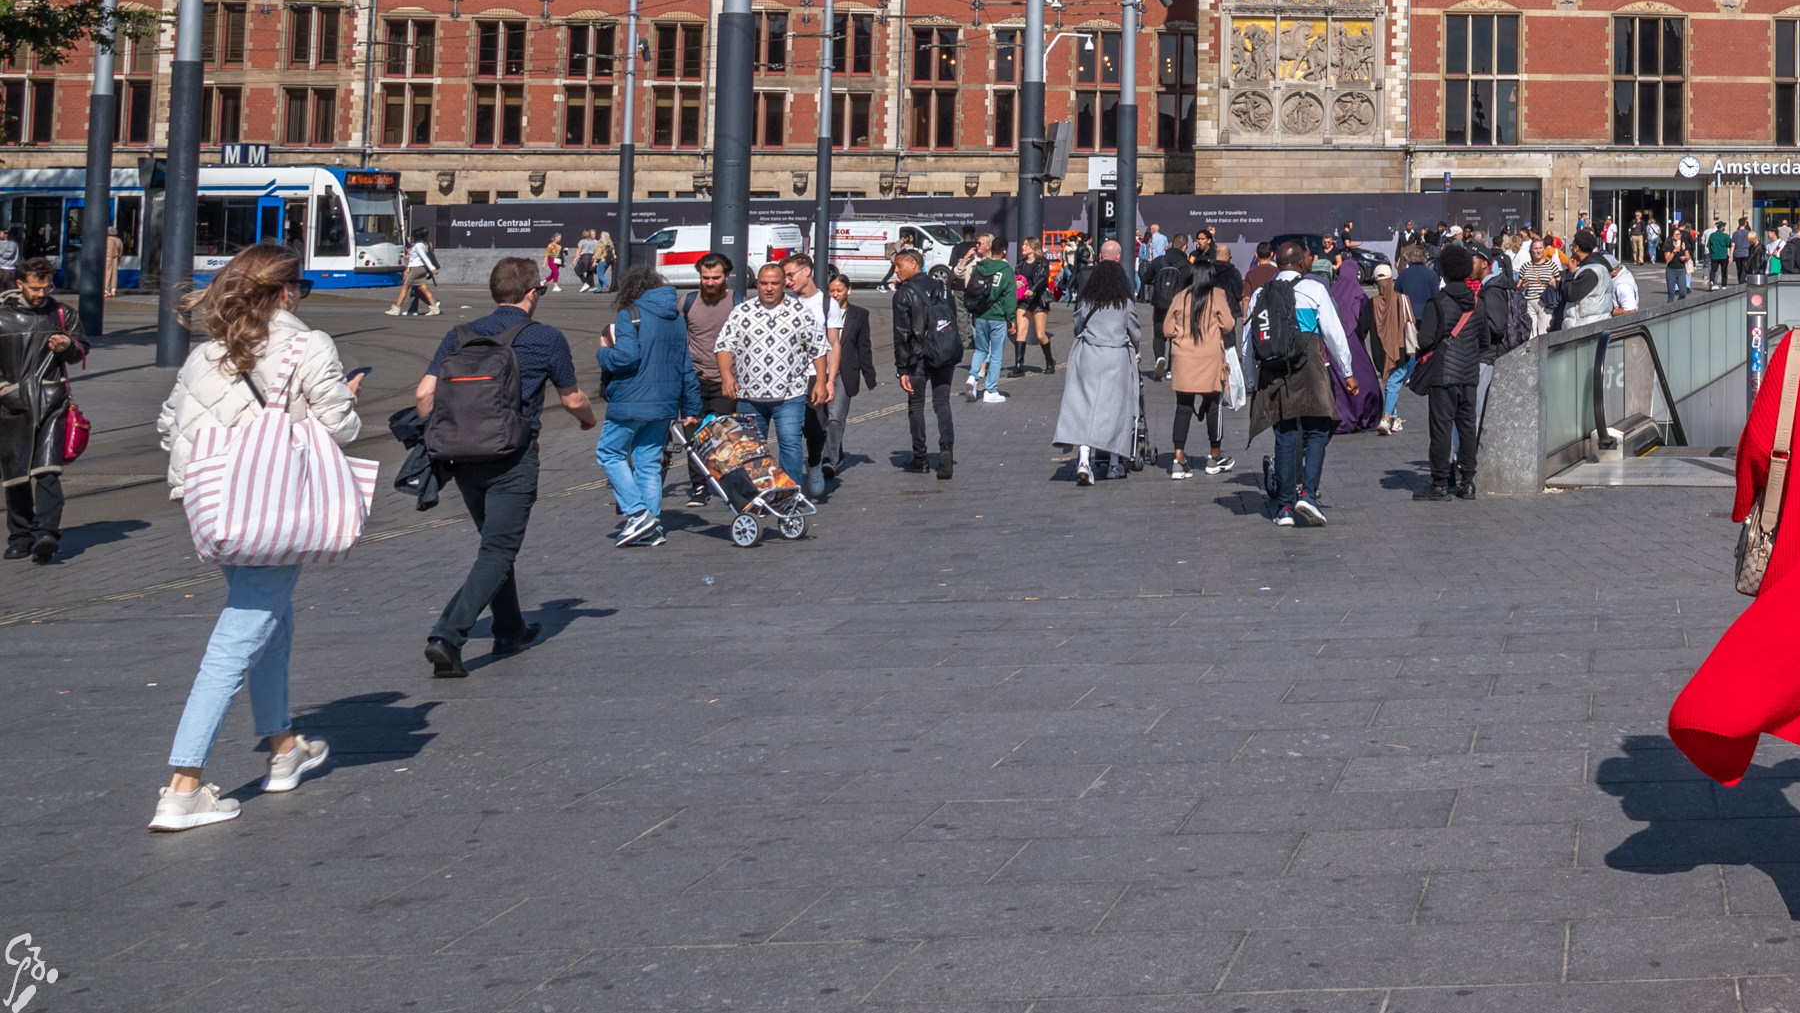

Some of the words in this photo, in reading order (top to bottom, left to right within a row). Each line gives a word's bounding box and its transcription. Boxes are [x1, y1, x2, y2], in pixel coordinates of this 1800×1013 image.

[224, 145, 241, 165] M
[248, 145, 266, 165] M
[1105, 201, 1115, 218] B
[451, 219, 495, 228] Amsterdam
[496, 218, 531, 227] Centraal
[1258, 308, 1271, 341] FILA
